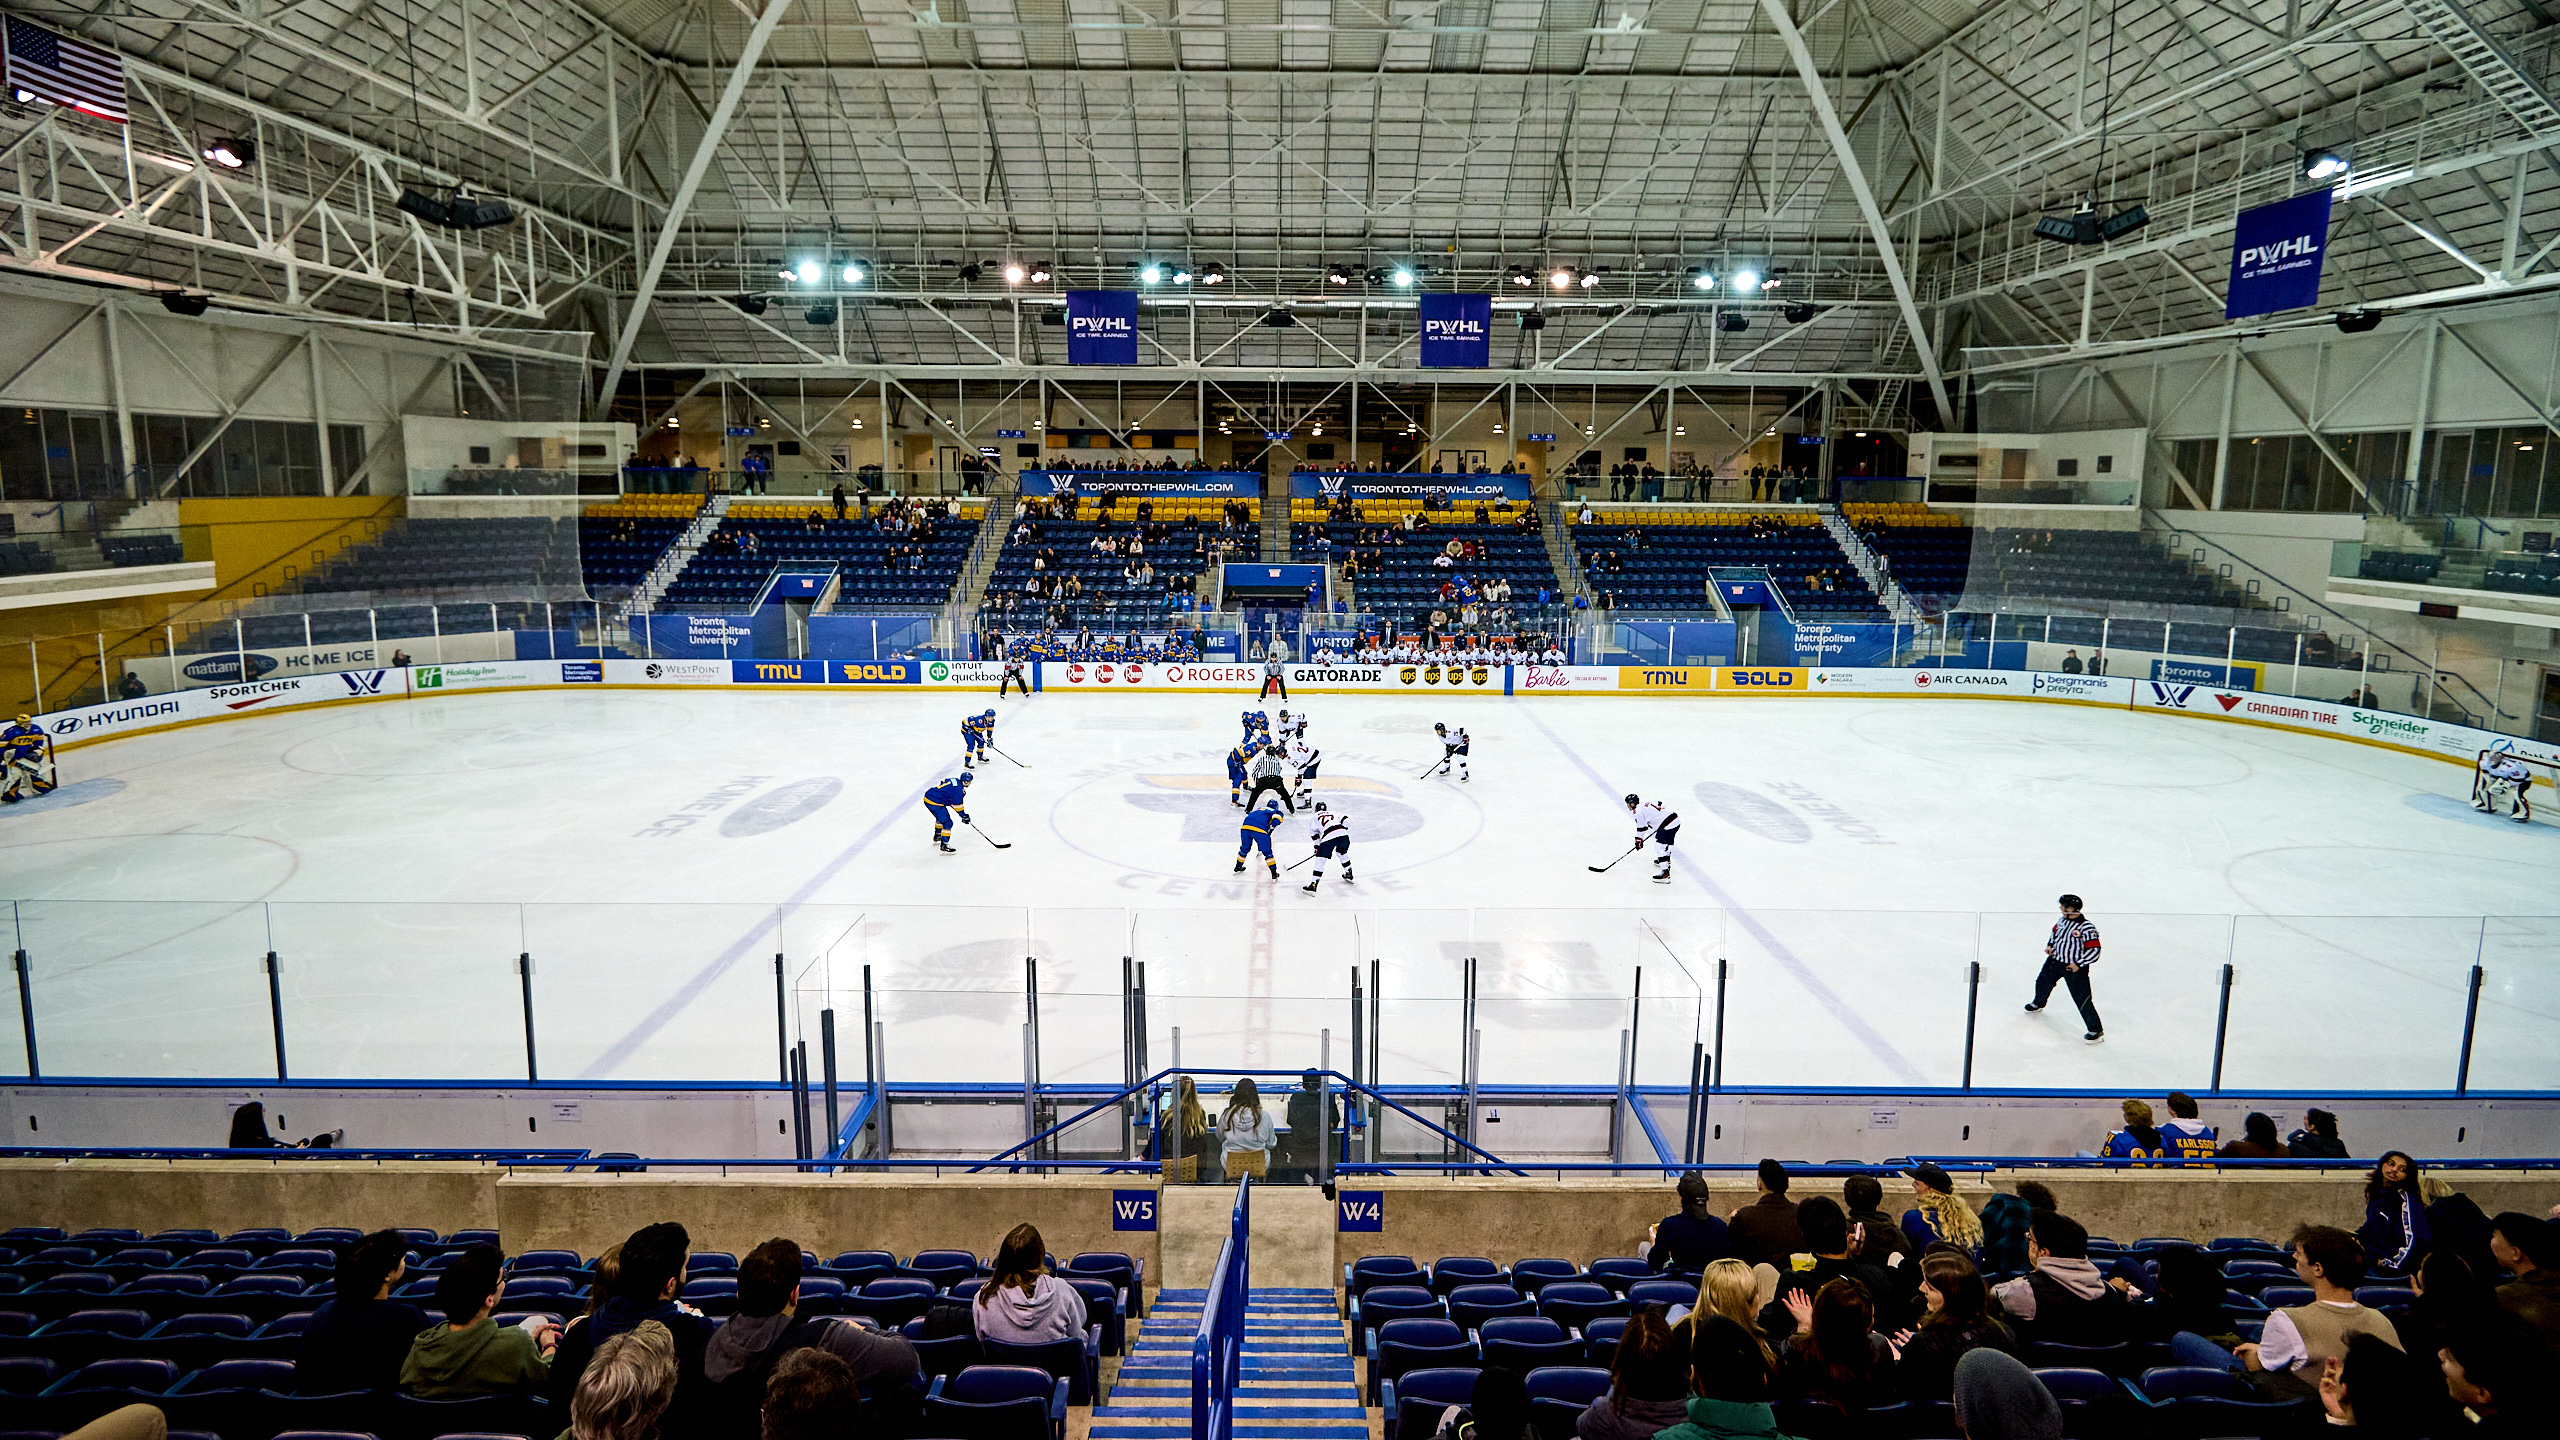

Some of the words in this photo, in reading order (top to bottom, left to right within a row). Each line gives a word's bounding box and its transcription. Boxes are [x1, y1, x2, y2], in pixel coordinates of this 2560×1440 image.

[2240, 235, 2319, 267] PWHL
[1073, 317, 1131, 331] PWHL
[1426, 320, 1484, 334] PWHL
[1081, 482, 1234, 492] TORONTO.THEPWHL.COM
[1351, 485, 1504, 494] TORONTO.THEPWHL.COM
[688, 616, 728, 626] Toronto
[688, 626, 751, 636] Metropolitan
[1795, 624, 1832, 633] Toronto
[689, 635, 739, 646] University
[1794, 633, 1856, 644] Metropolitan
[1794, 643, 1843, 654] University
[347, 650, 374, 663] ICE
[186, 660, 240, 676] mattam
[446, 667, 480, 676] Holiday
[482, 666, 496, 674] Inn
[755, 664, 801, 680] TMU
[844, 664, 906, 680] BOLD
[1188, 668, 1256, 681] ROGERS
[951, 671, 1016, 684] quickboos
[1294, 669, 1382, 682] GATORADE
[1401, 672, 1416, 683] ups
[1425, 672, 1440, 683] ups
[1448, 672, 1463, 683] ups
[1472, 672, 1487, 683] ups
[1525, 666, 1569, 688] Barbie
[1643, 671, 1687, 685] TMU
[1732, 671, 1793, 686] BOLD
[1934, 675, 1953, 684] AIR
[1955, 675, 2008, 686] CANADA
[2047, 675, 2108, 687] bergmanis
[2047, 685, 2083, 695] preyra
[88, 701, 180, 728] HYUNDAI
[2247, 702, 2309, 720] CANADIAN
[2312, 711, 2337, 725] TIRE
[2352, 711, 2429, 735] Schneider
[2384, 728, 2426, 743] Electric
[2176, 1138, 2216, 1149] KARLSSON
[1115, 1201, 1153, 1220] W5
[1341, 1201, 1381, 1222] W4
